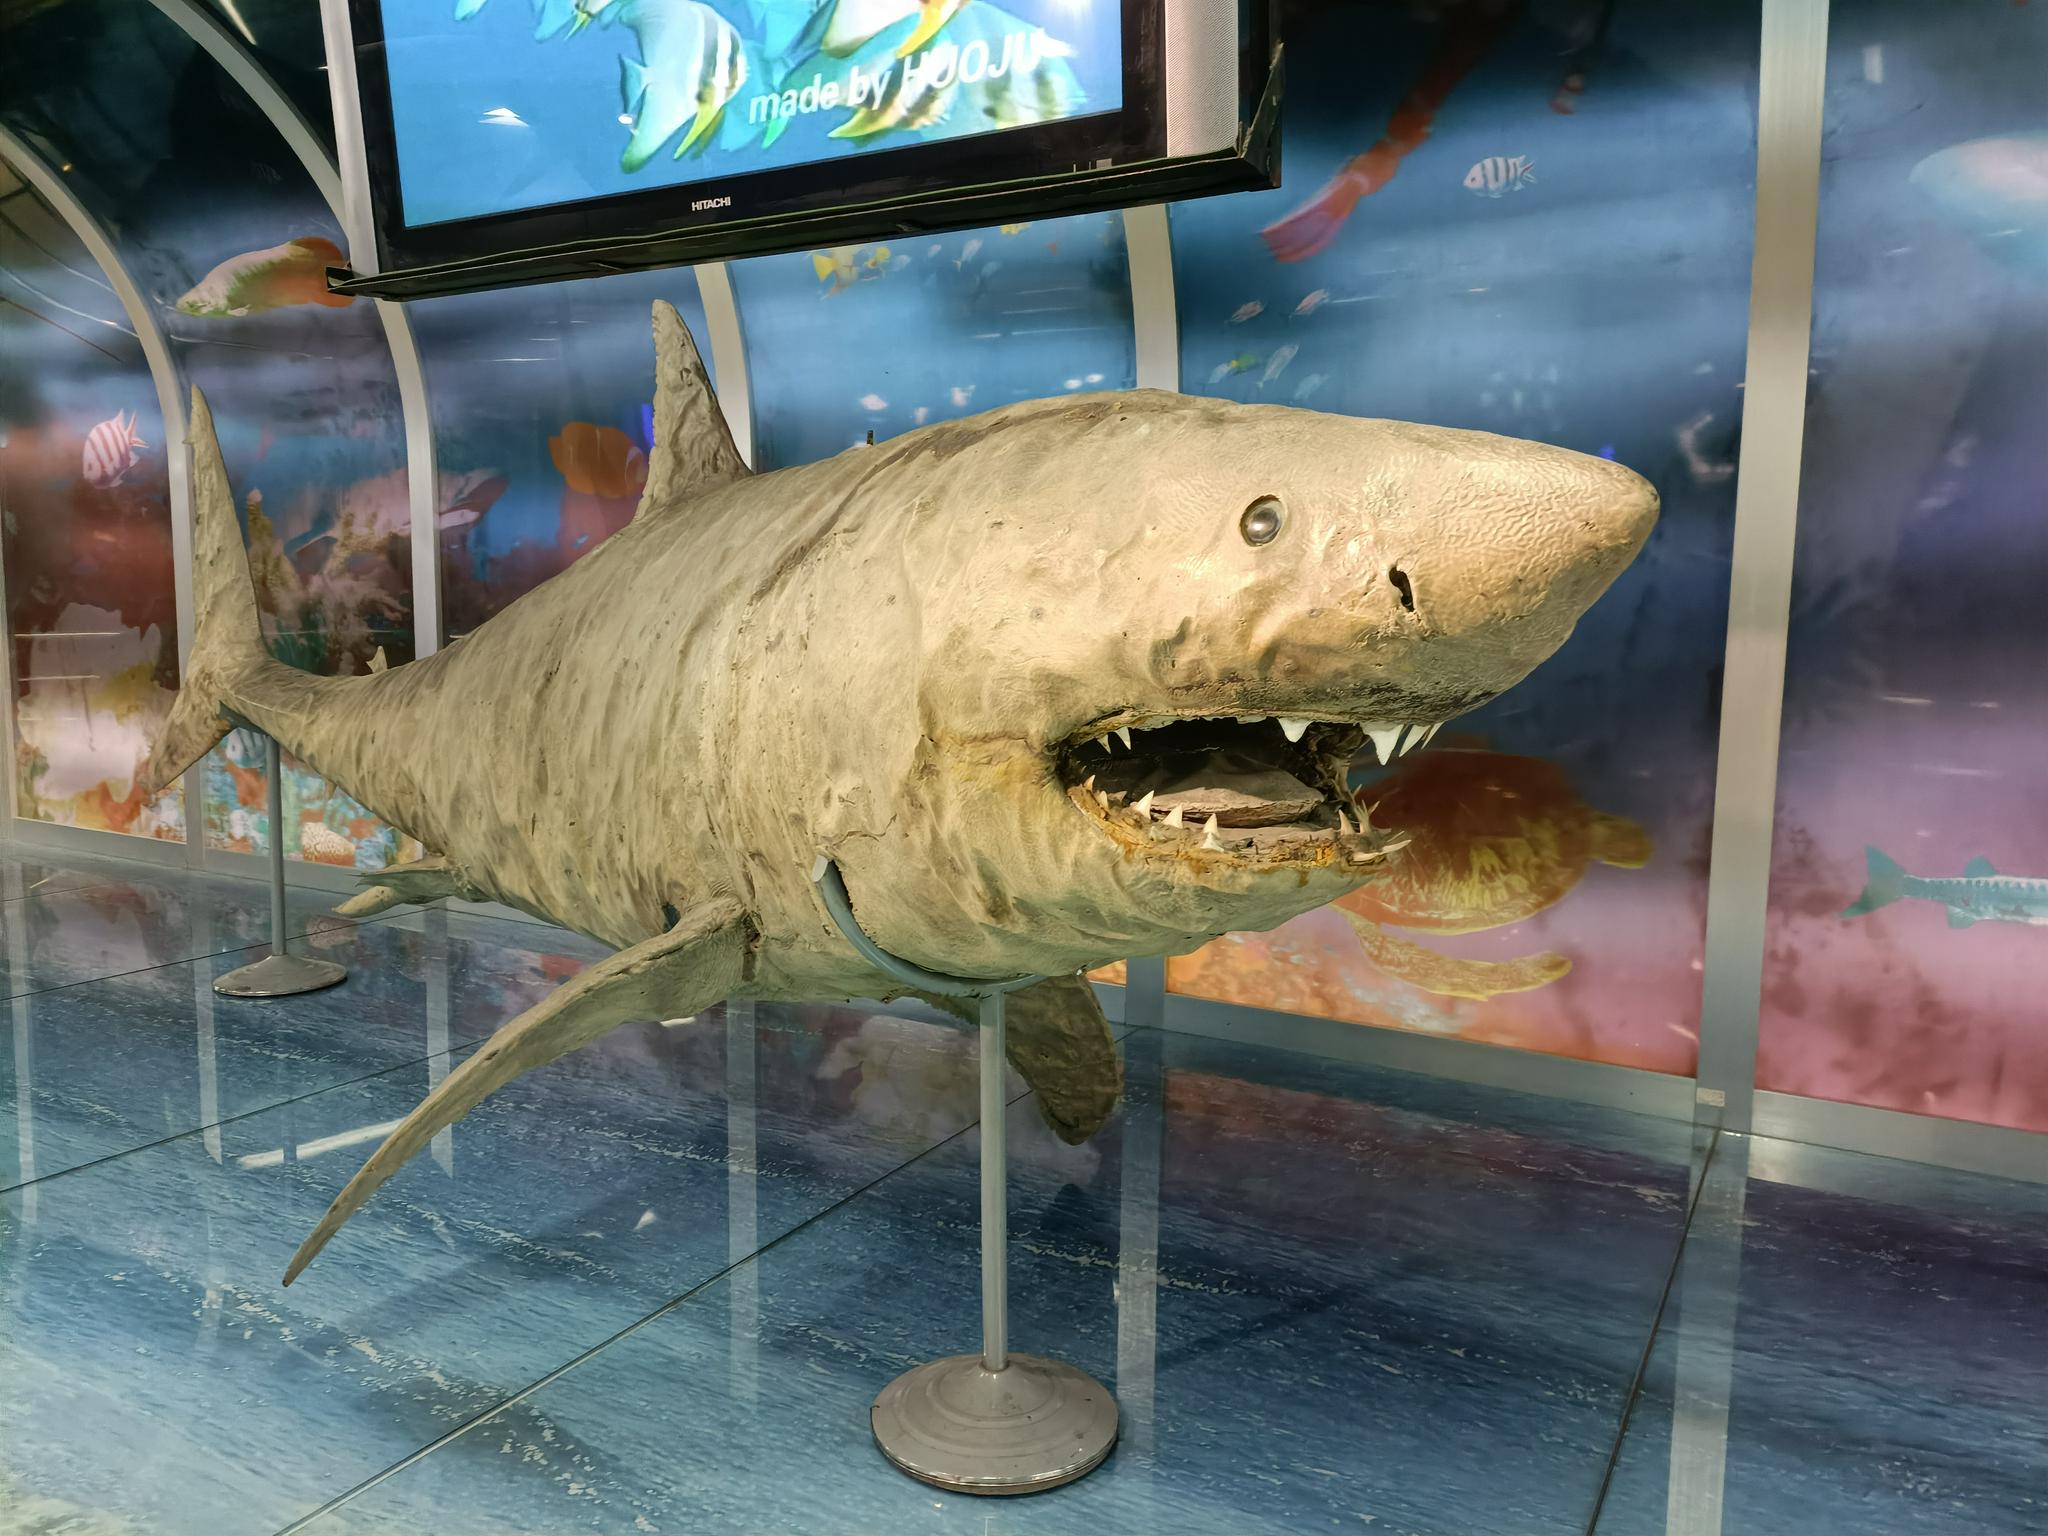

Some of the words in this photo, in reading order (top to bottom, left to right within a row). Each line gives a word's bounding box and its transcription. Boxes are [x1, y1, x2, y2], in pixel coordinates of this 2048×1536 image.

[748, 73, 839, 124] made
[847, 65, 892, 111] by
[691, 196, 731, 211] HITACHI
